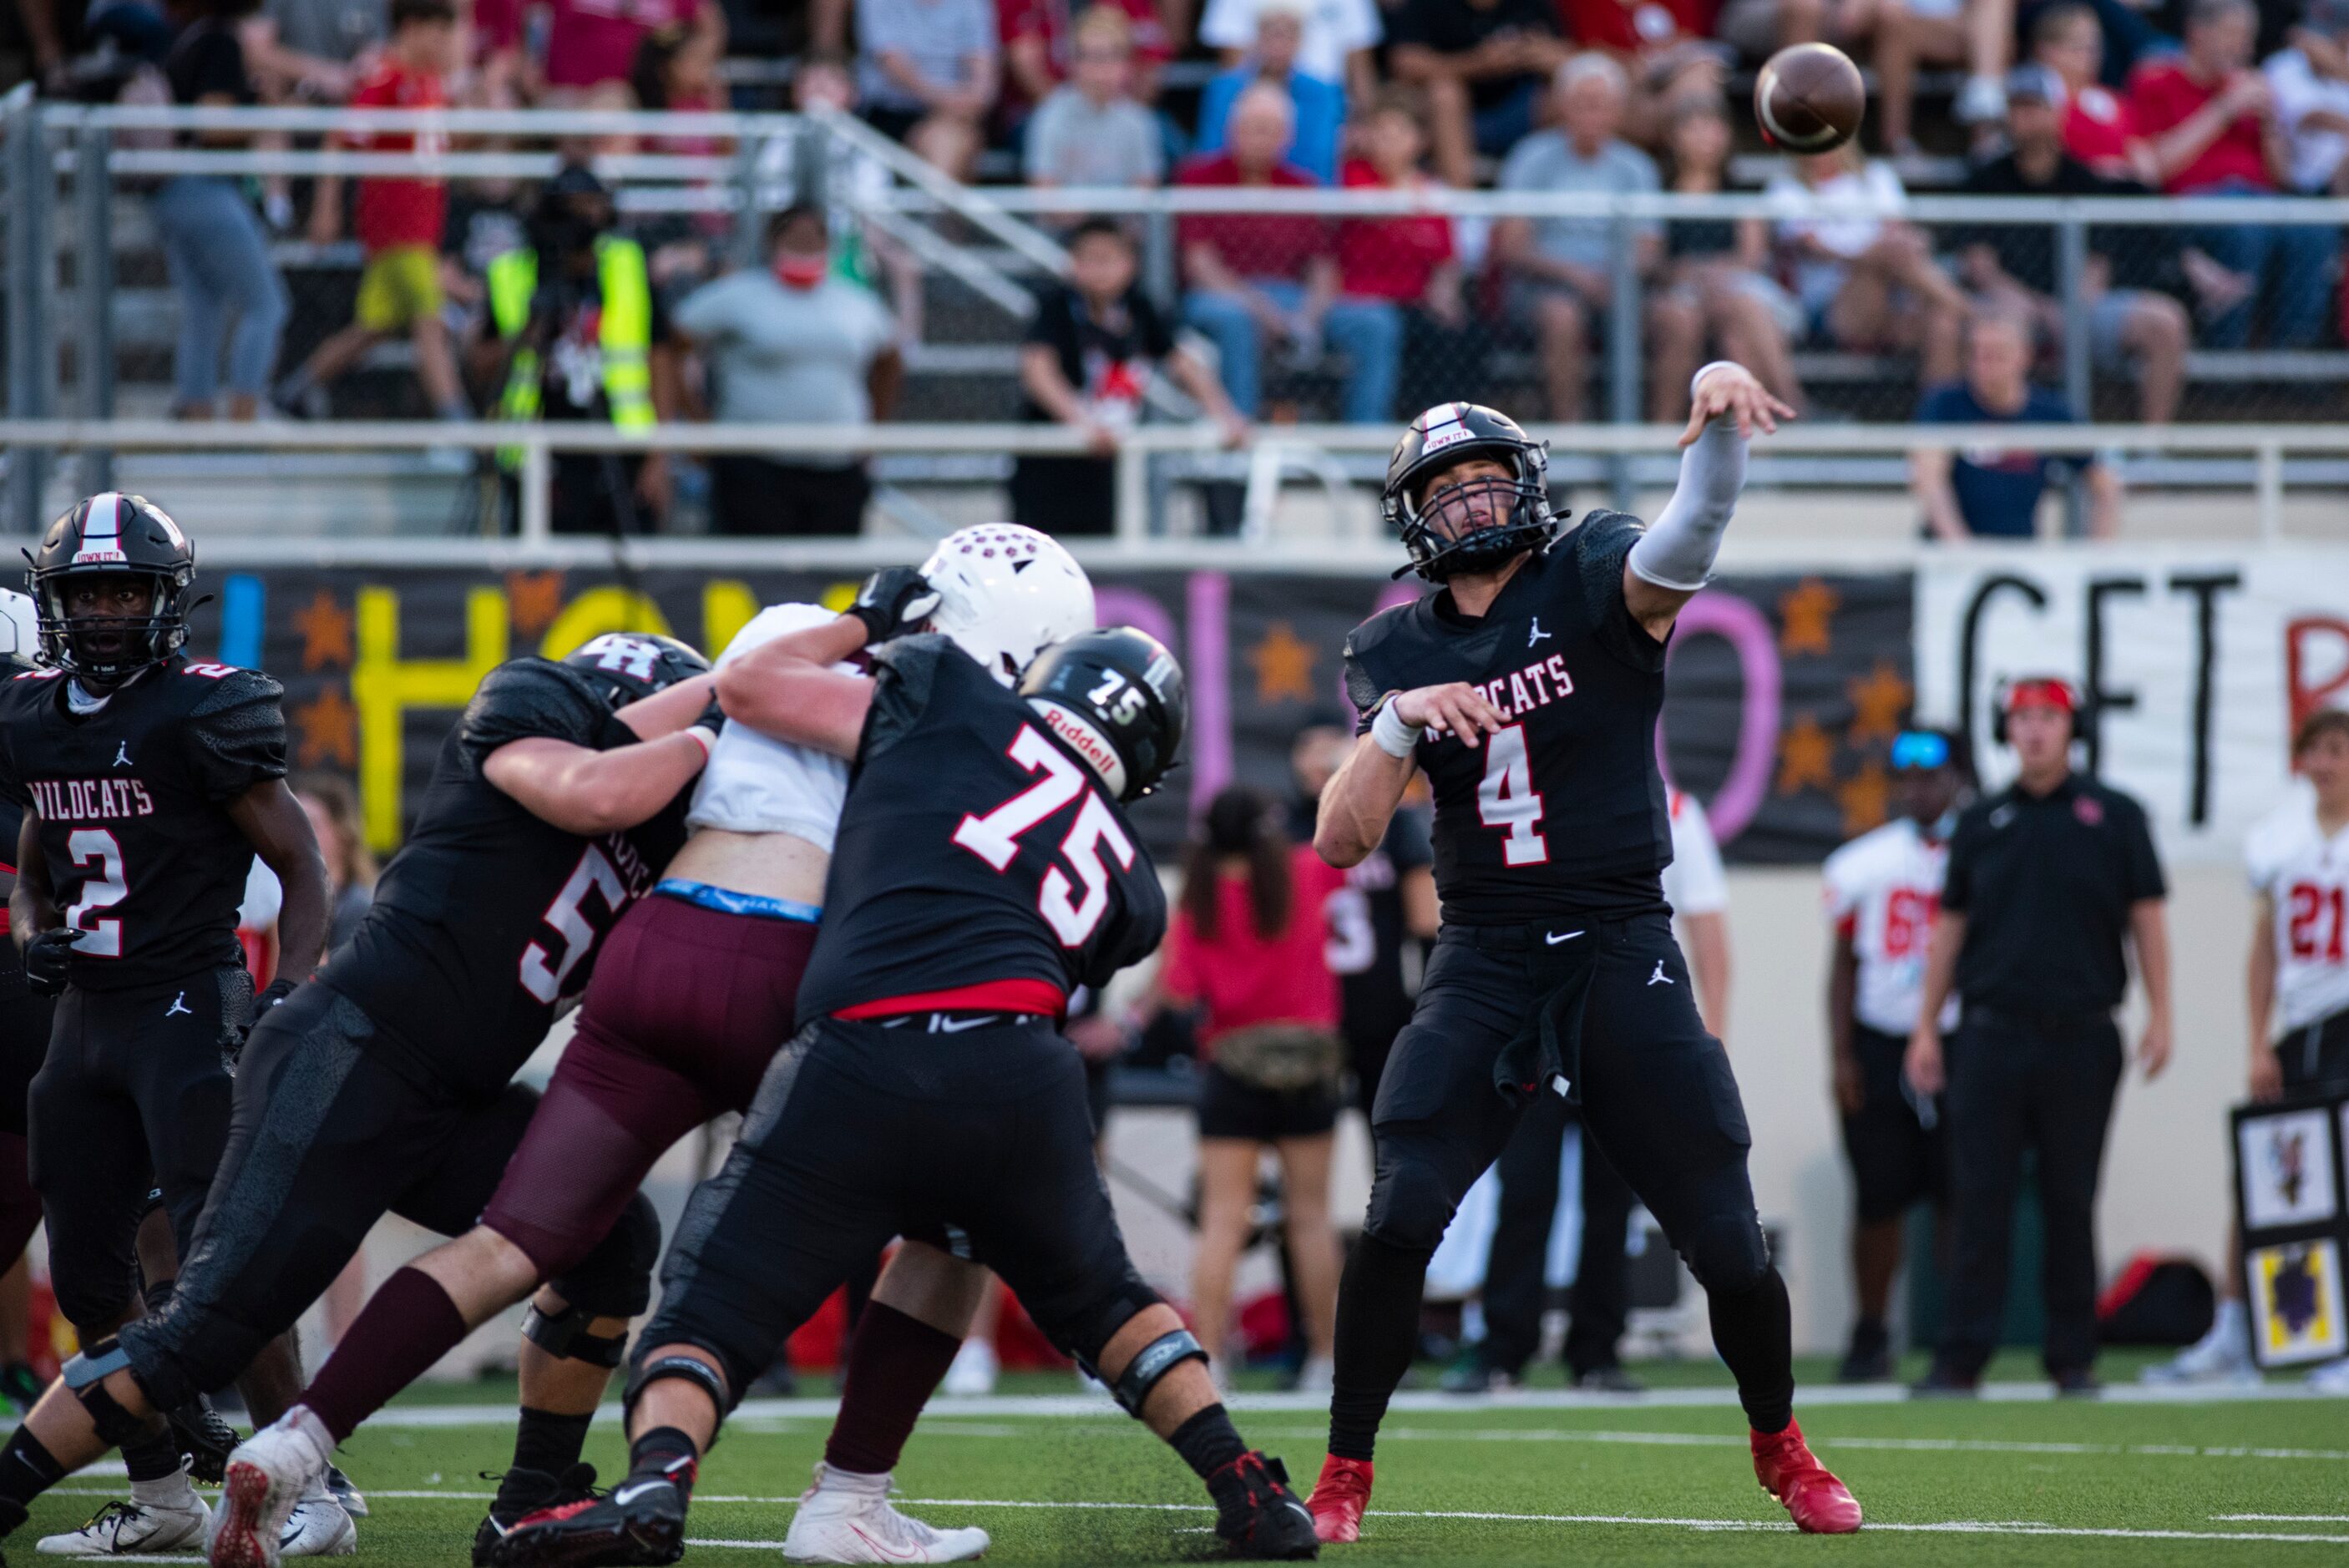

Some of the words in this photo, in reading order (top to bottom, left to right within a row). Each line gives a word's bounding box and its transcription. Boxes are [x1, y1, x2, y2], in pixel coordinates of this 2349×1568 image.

[1086, 667, 1147, 726] 75
[1045, 708, 1117, 776] Riddell
[25, 777, 154, 822] WILDCATS
[949, 720, 1137, 949] 75
[1475, 720, 1551, 869] 4
[65, 825, 129, 959] 2
[2289, 882, 2343, 962] 21
